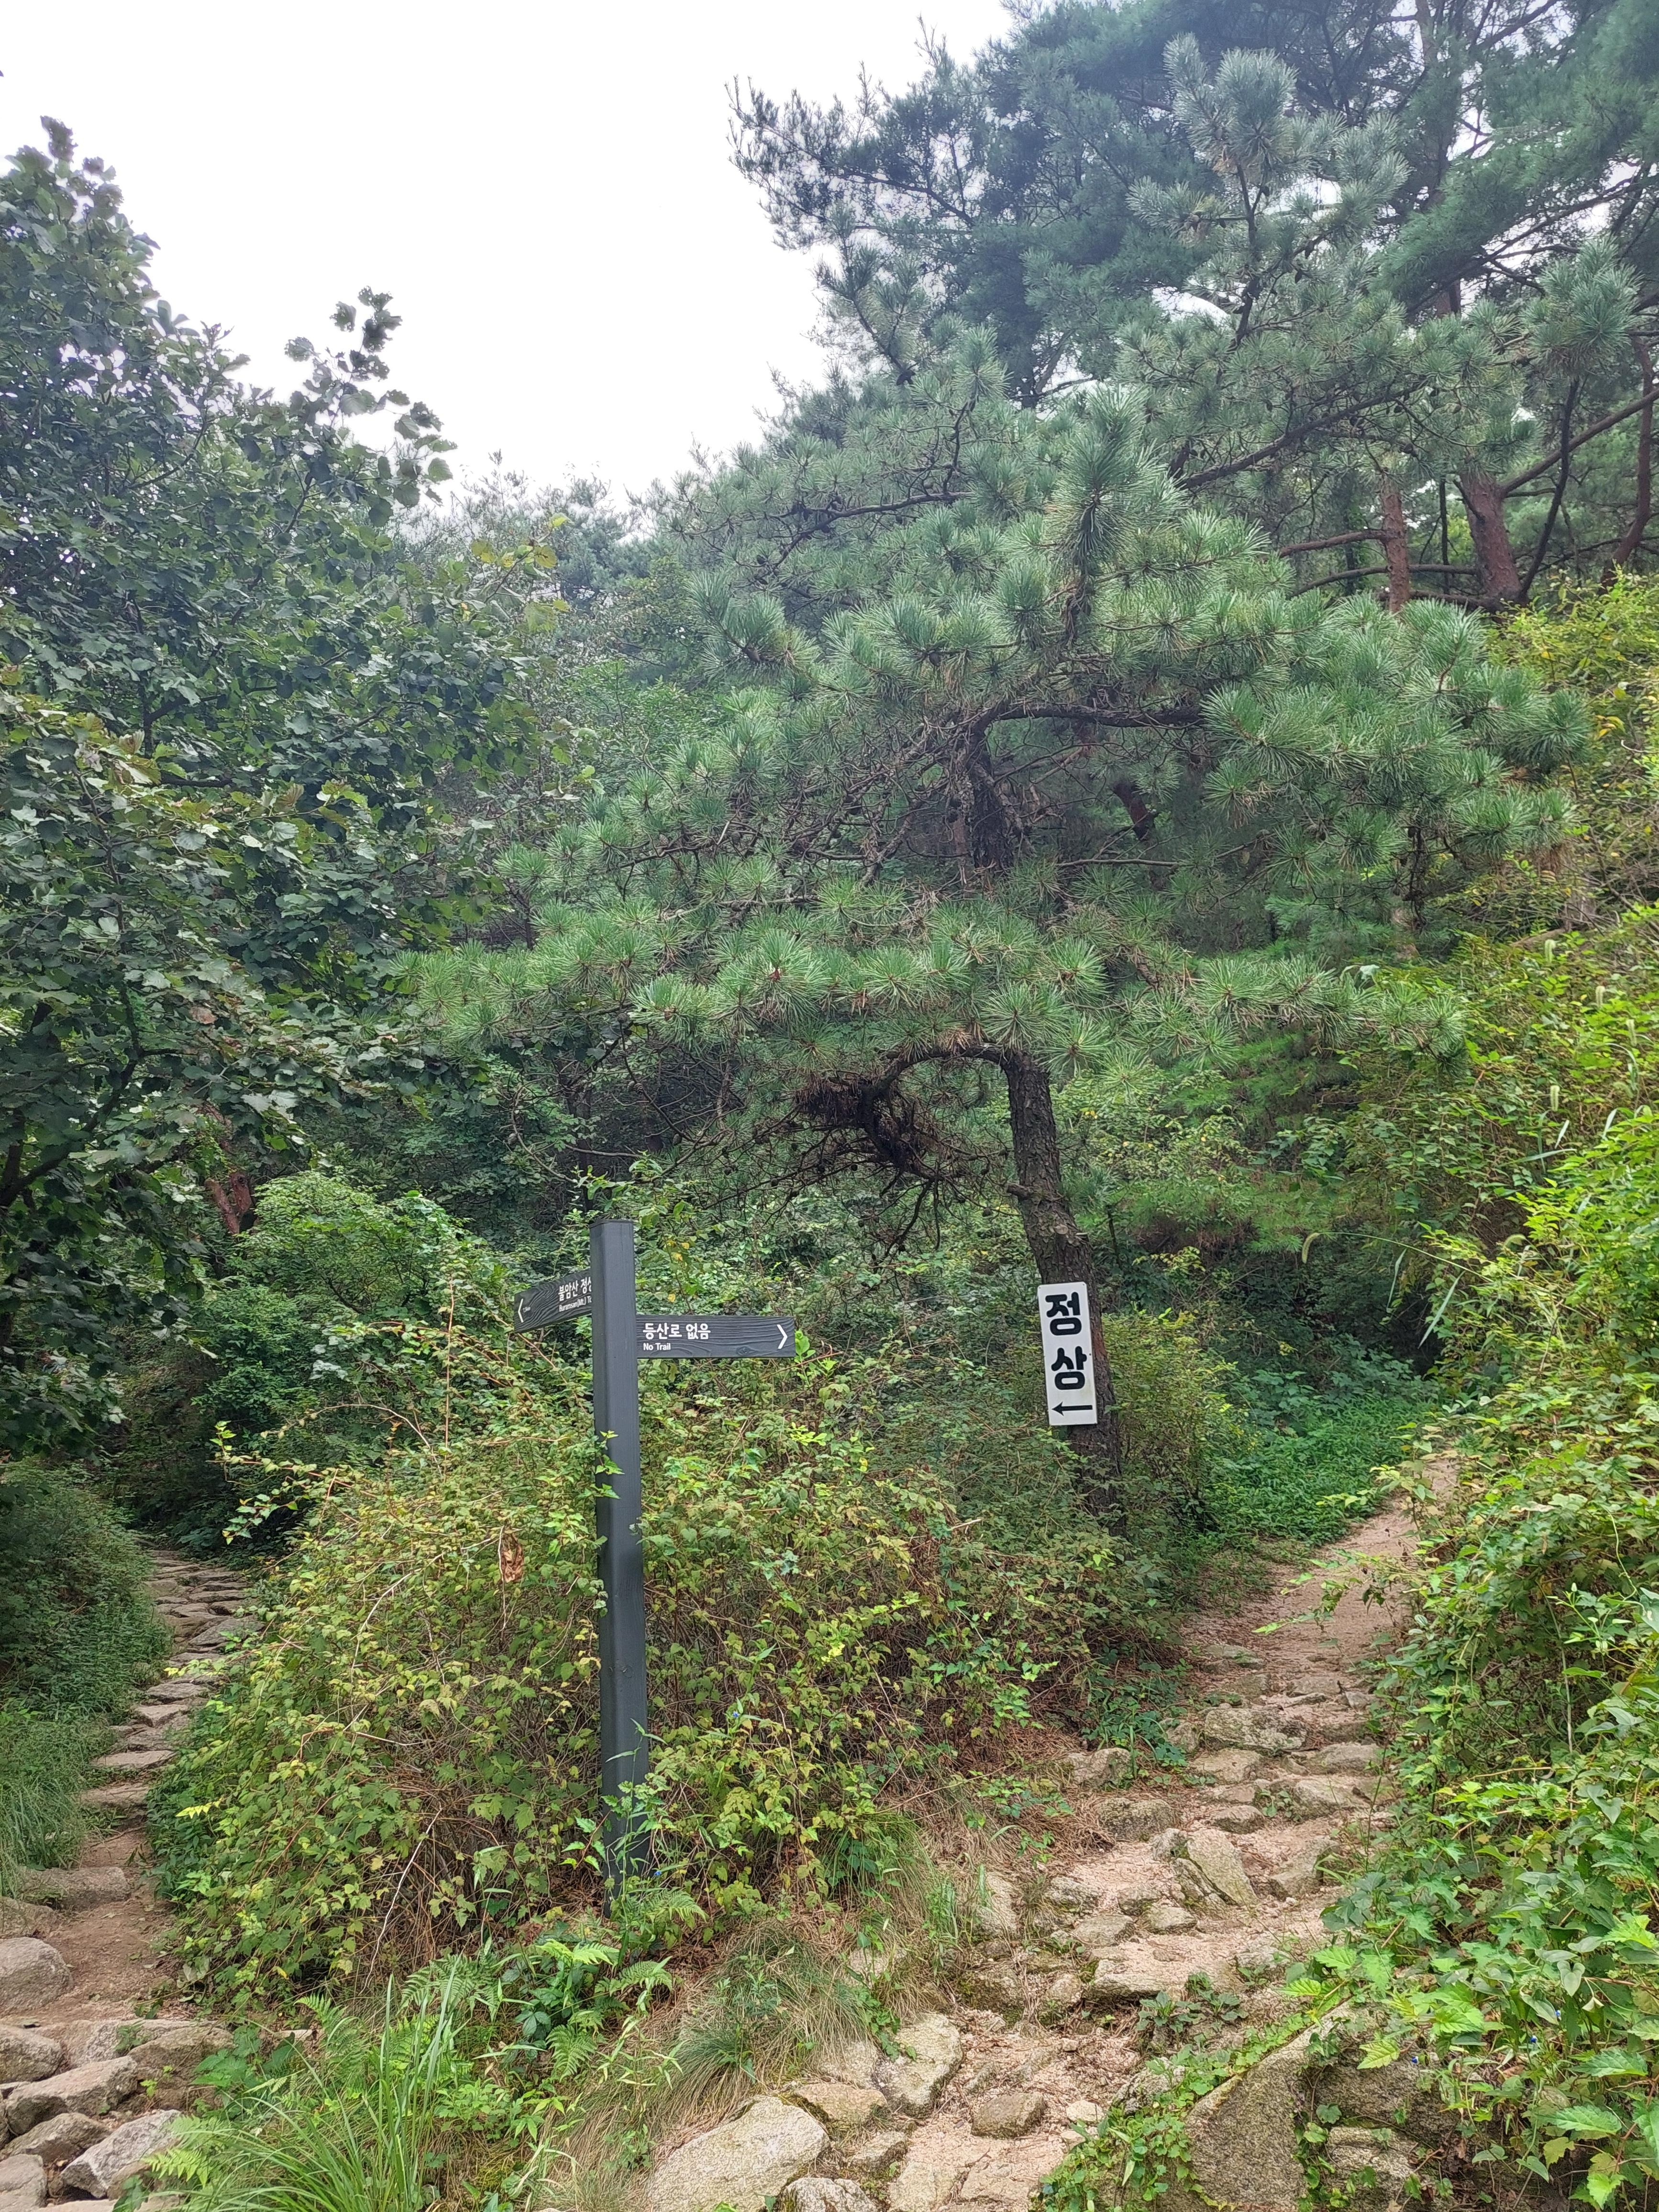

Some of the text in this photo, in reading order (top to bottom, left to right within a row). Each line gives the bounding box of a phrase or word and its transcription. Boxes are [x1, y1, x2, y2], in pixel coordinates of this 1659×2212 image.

[558, 1280, 579, 1302] 불암산
[642, 1323, 711, 1339] 등산로 없음
[656, 1342, 671, 1350] Trail
[1045, 1292, 1087, 1390] 정상
